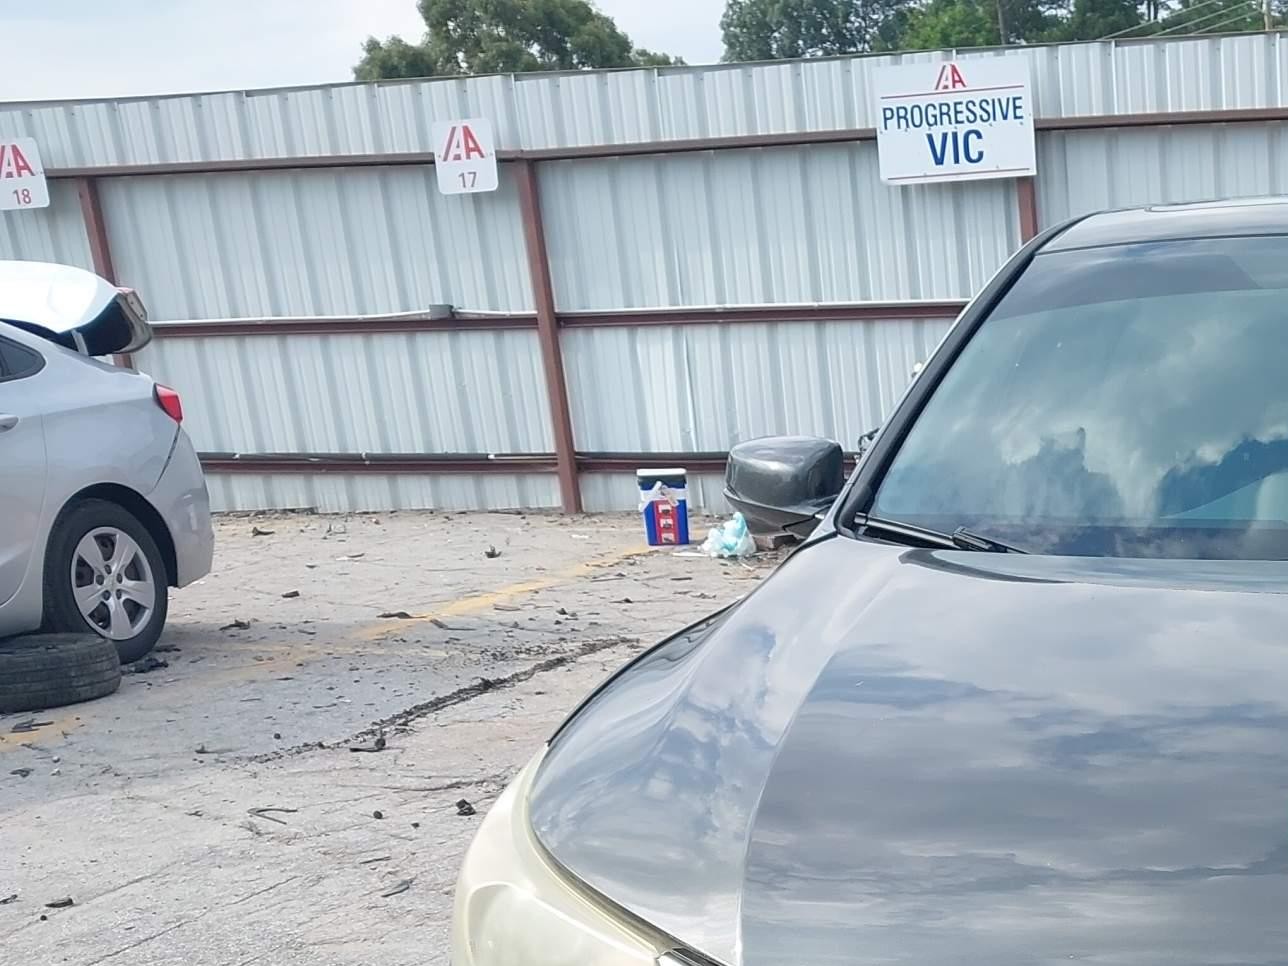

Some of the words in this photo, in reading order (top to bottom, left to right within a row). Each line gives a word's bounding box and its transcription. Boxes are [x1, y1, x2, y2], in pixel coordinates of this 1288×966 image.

[882, 96, 1024, 131] PROGRESSIVE
[926, 129, 984, 166] VIC
[458, 171, 478, 189] 17
[12, 188, 32, 205] 18
